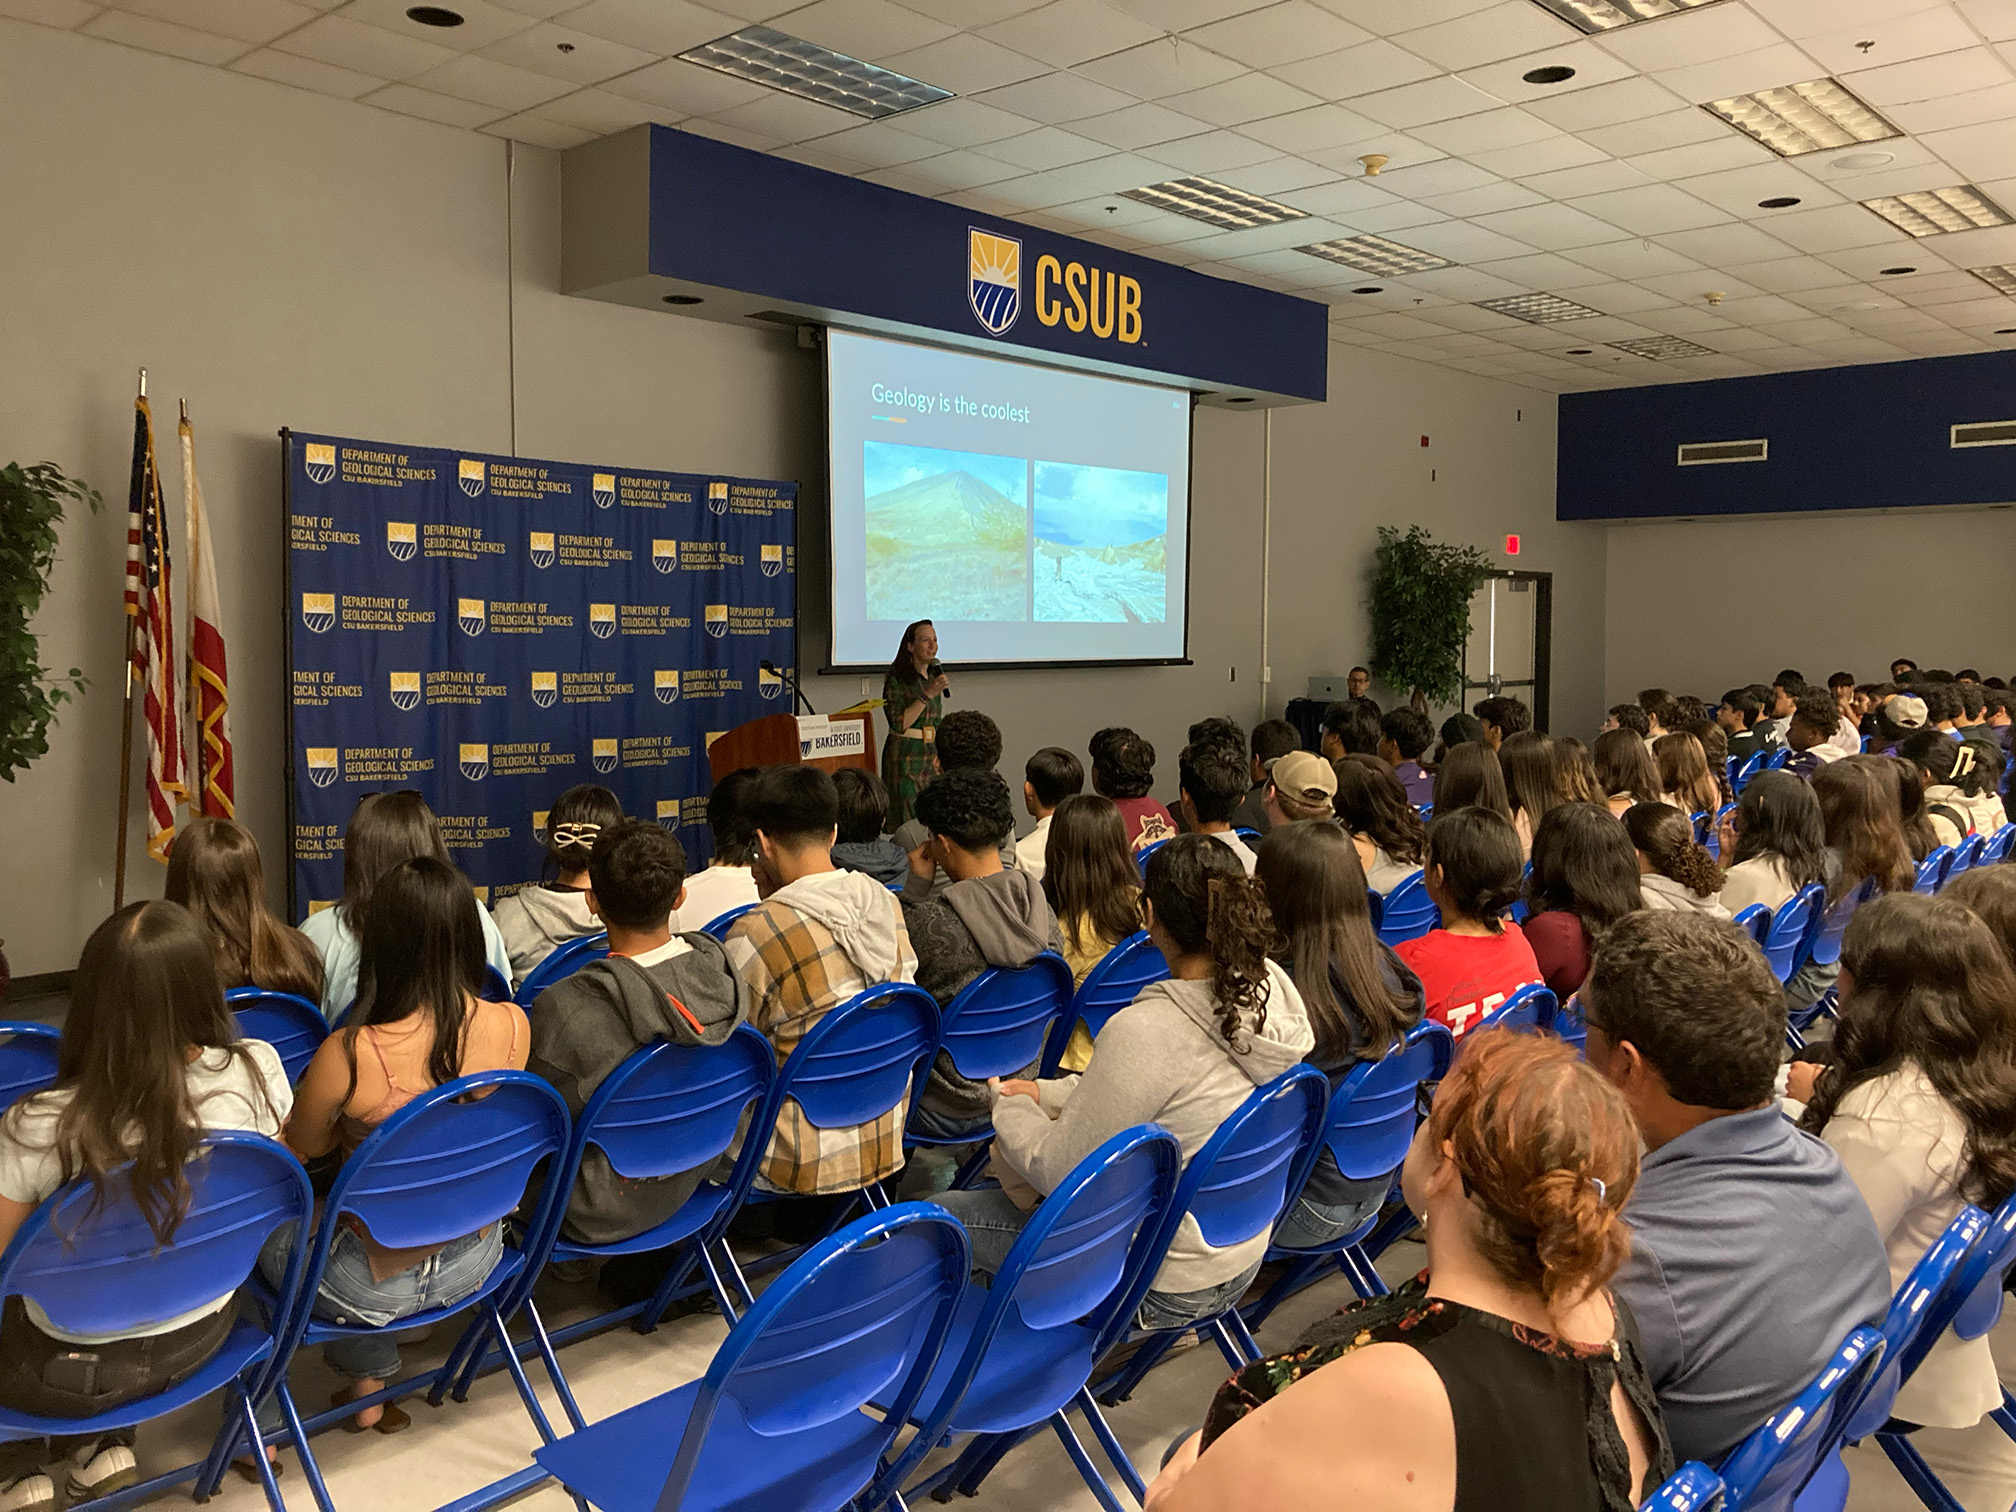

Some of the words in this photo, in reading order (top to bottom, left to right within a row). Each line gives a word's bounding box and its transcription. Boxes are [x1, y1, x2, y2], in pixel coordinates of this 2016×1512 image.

[1035, 254, 1142, 344] CSUB
[872, 382, 935, 414] Geology
[939, 392, 950, 412] is
[954, 395, 977, 416] the
[981, 402, 1030, 424] coolest
[342, 447, 396, 464] DEPARTMENT
[398, 455, 410, 466] OF
[342, 461, 394, 478] GEOLOGICAL
[396, 467, 437, 480] SCIENCES
[490, 464, 538, 478] DEPARTMENT
[538, 469, 549, 479] OF
[490, 476, 535, 490] GEOLOGICAL
[536, 480, 572, 494] SCIENCES
[662, 480, 671, 490] OF
[620, 488, 660, 500] GEOLOGICAL
[766, 488, 777, 498] OF
[321, 517, 334, 529] OF
[318, 532, 360, 545] SCIENCES
[472, 528, 483, 539] OF
[603, 537, 614, 547] OF
[342, 595, 395, 609] DEPARTMENT
[398, 599, 409, 610] OF
[490, 601, 537, 613] DEPARTMENT
[538, 603, 548, 614] OF
[342, 609, 393, 622] GEOLOGICAL
[395, 611, 436, 623] SCIENCES
[660, 606, 671, 616] OF
[766, 607, 775, 617] OF
[490, 614, 535, 626] GEOLOGICAL
[536, 615, 573, 627] SCIENCES
[323, 671, 336, 683] OF
[476, 672, 486, 683] OF
[605, 672, 616, 682] OF
[293, 685, 318, 697] GICAL
[321, 685, 362, 697] SCIENCES
[663, 736, 672, 746] OF
[815, 732, 861, 750] BAKERSFIELD
[345, 748, 400, 760] DEPARTMENT
[401, 748, 413, 759] OF
[492, 743, 539, 755] DEPARTMENT
[541, 742, 551, 753] OF
[345, 760, 396, 773] GEOLOGICAL
[492, 755, 538, 767] GEOLOGICAL
[539, 754, 575, 766] SCIENCES
[345, 774, 358, 782] CSU
[478, 816, 488, 827] OF
[296, 826, 325, 837] TMENT
[327, 825, 338, 836] OF
[476, 827, 511, 839] SCIENCES
[295, 838, 323, 850] GICAL
